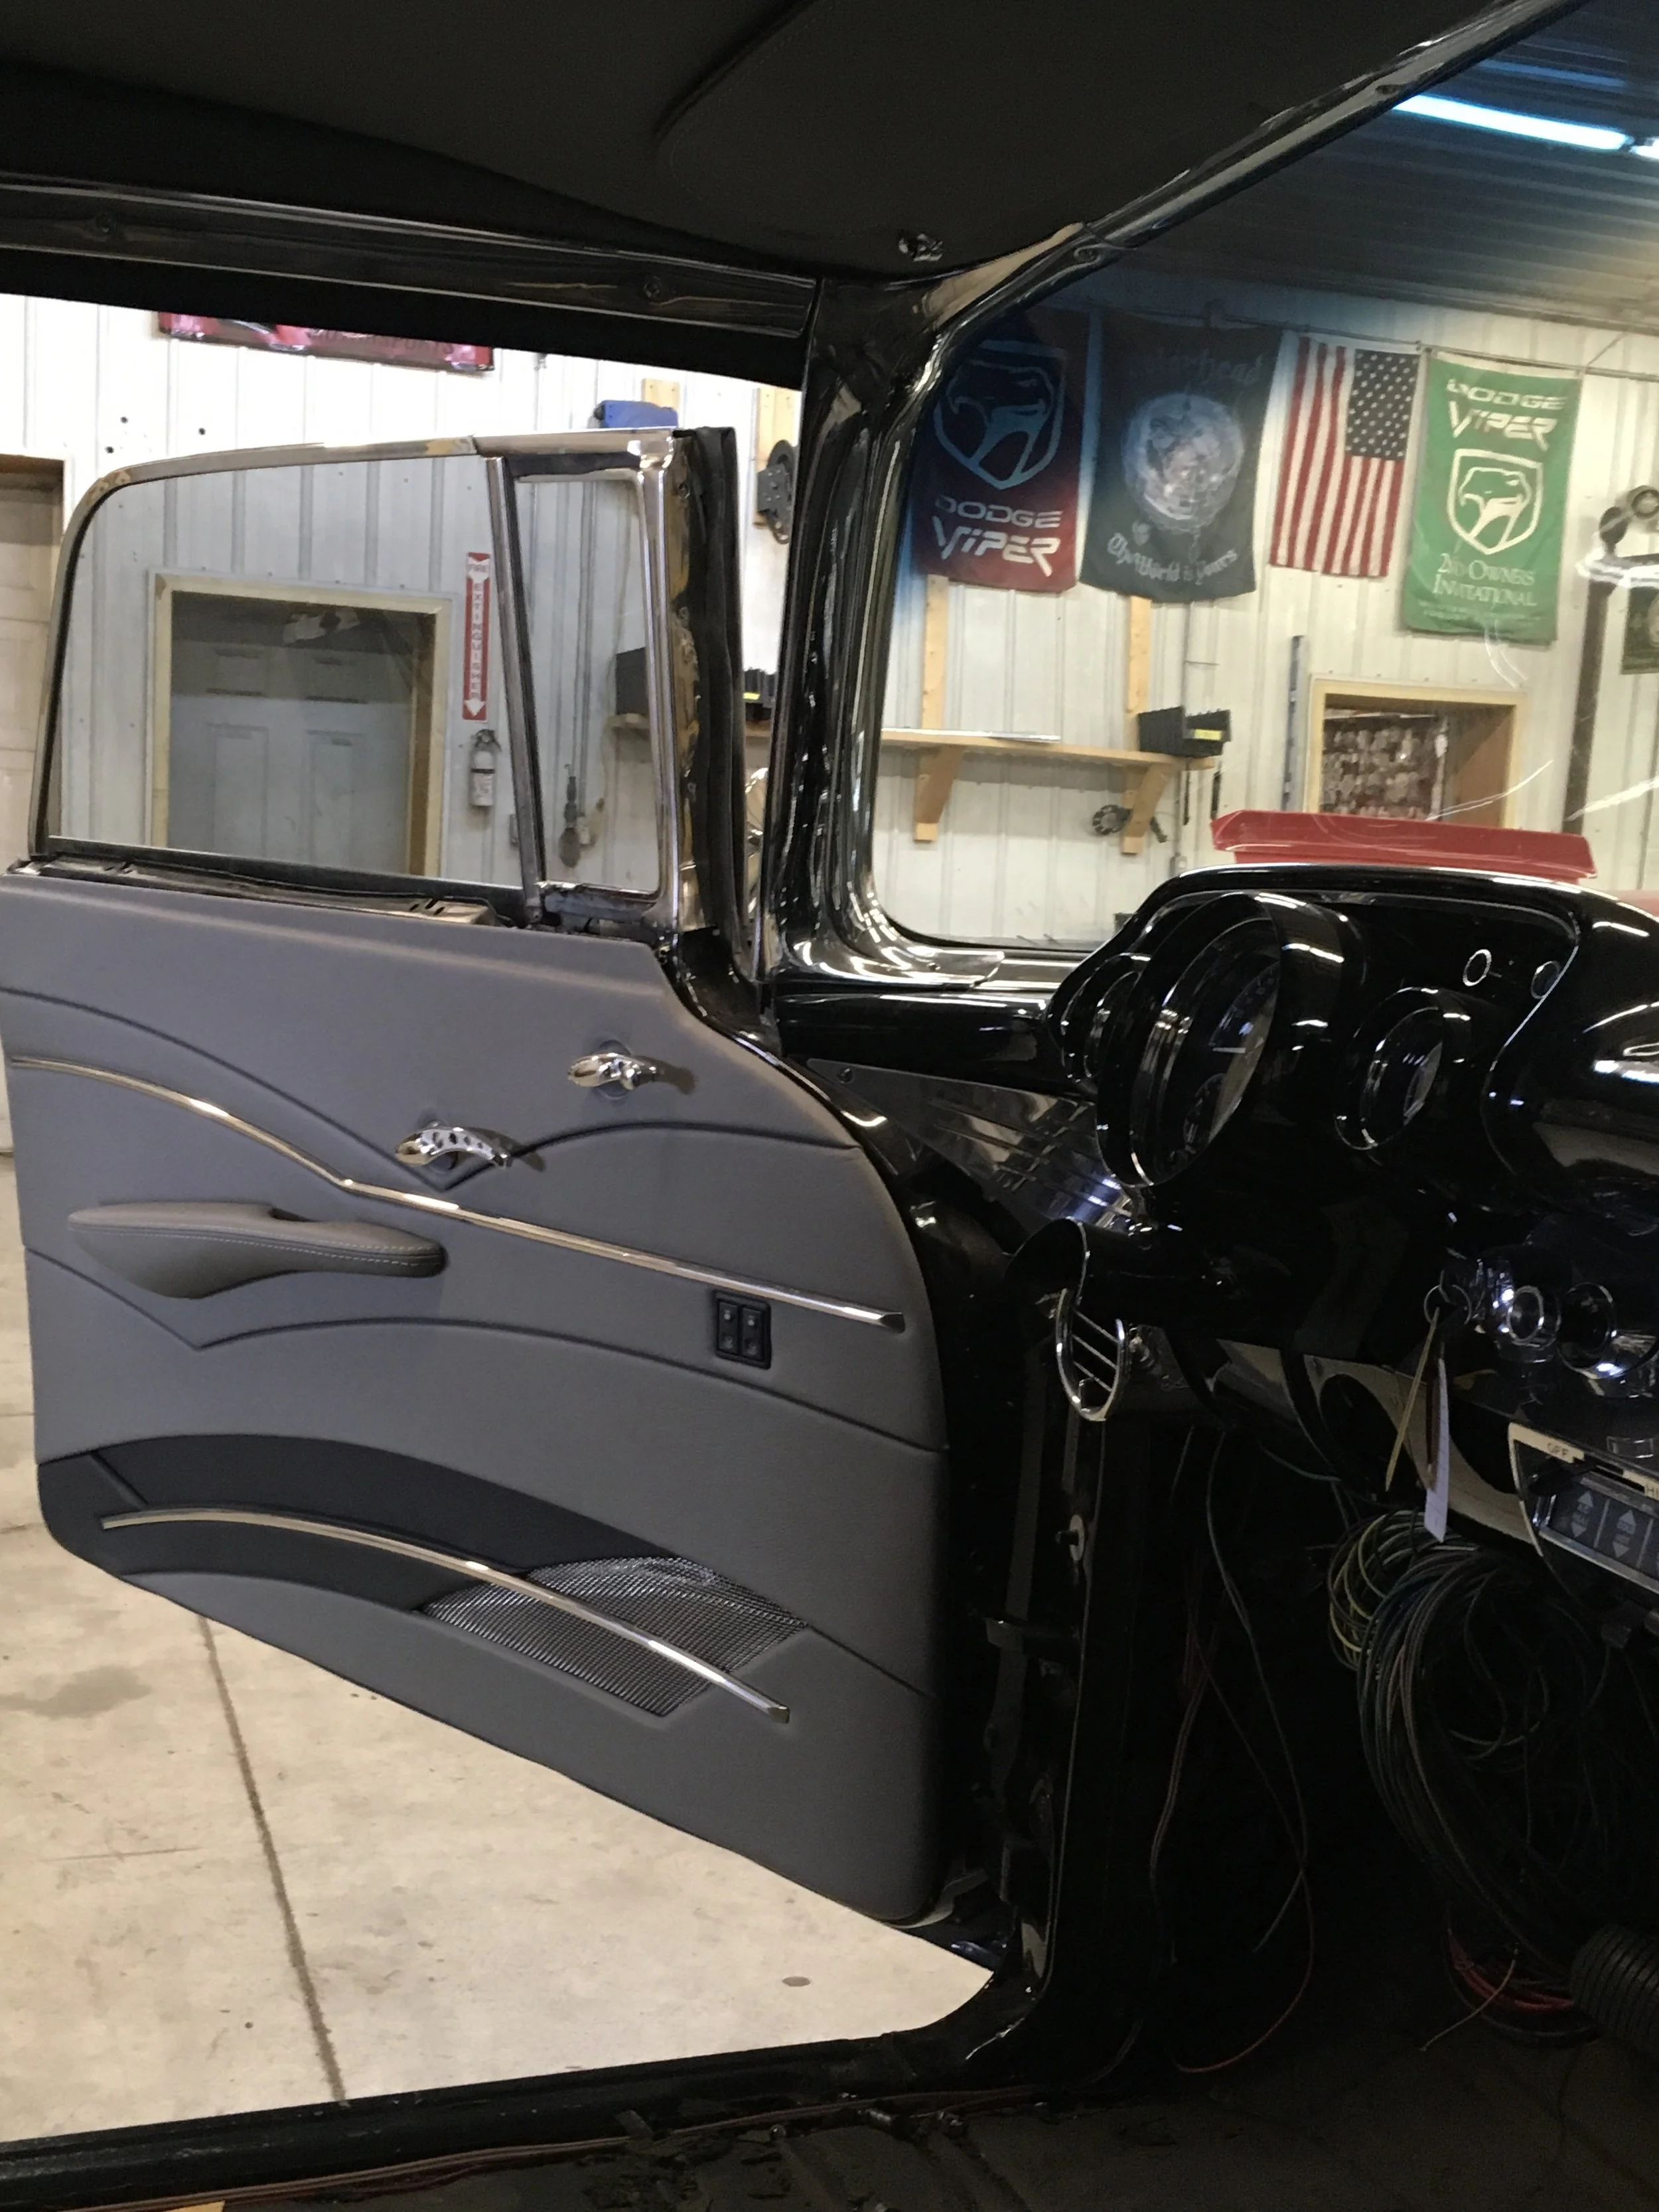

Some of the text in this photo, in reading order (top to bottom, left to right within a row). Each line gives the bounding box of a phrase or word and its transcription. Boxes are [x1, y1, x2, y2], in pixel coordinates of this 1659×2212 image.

[1446, 378, 1567, 409] DODGE
[934, 495, 1062, 528] DODGE
[467, 563, 489, 573] FIRE
[471, 583, 483, 697] EXTINGUISHER
